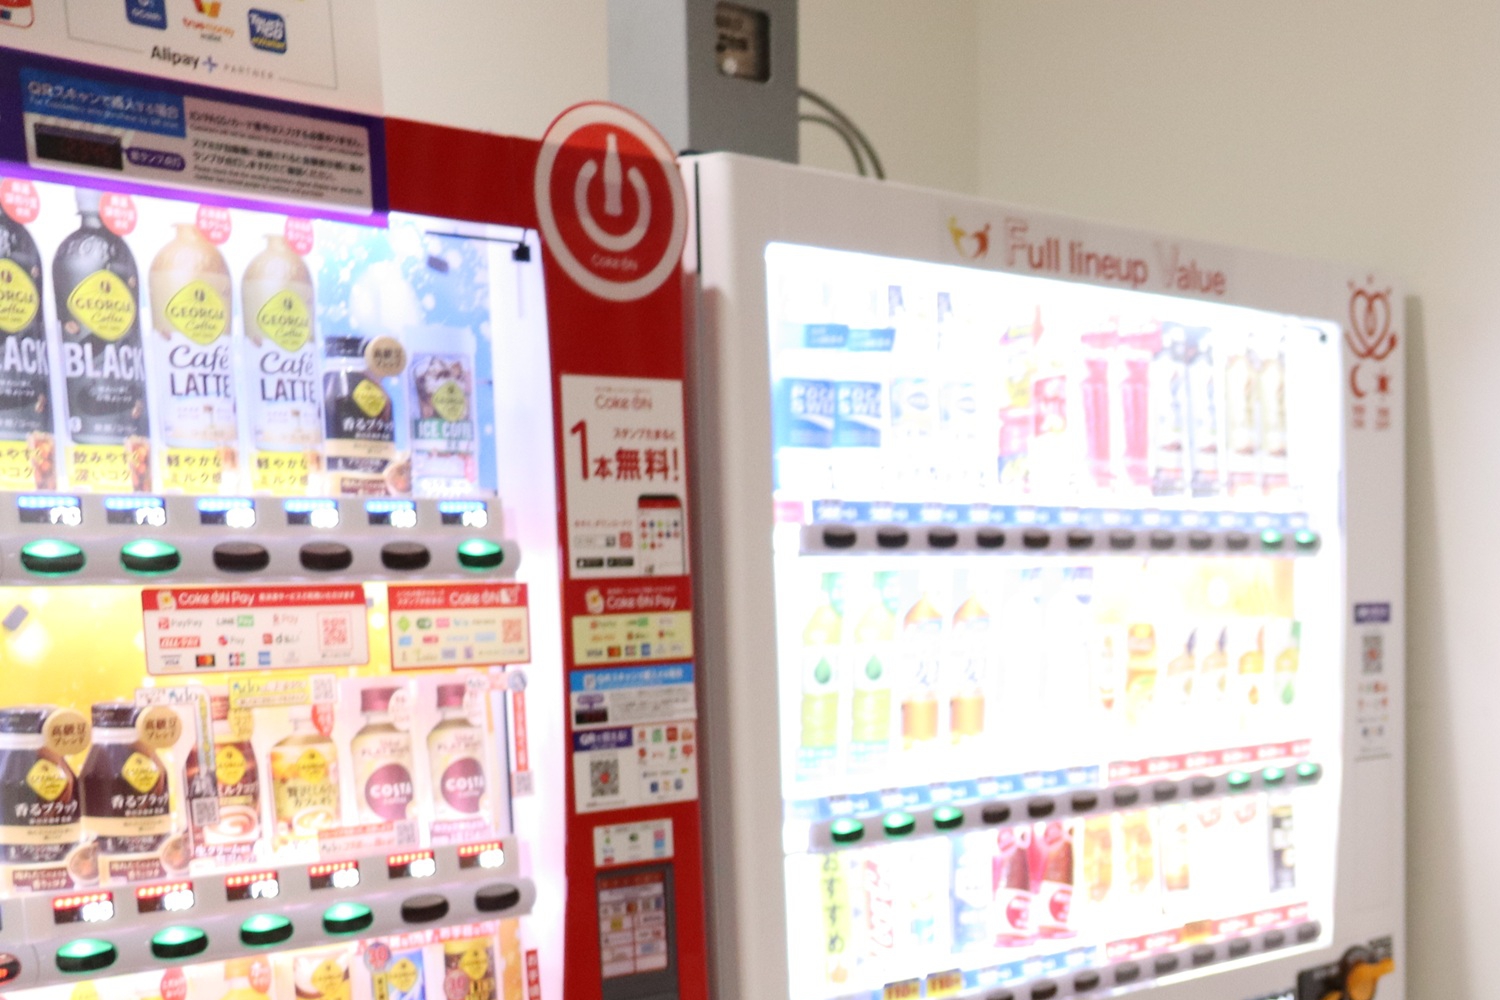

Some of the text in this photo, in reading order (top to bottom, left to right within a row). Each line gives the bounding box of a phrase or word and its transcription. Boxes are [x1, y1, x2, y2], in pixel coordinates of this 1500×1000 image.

[152, 46, 275, 80] Alipay PARTNER
[1005, 216, 1227, 295] Full lineup Value
[75, 297, 132, 314] GEORGIA
[170, 305, 225, 321] GEORGIA
[260, 312, 310, 328] GEORGIA
[0, 335, 50, 377] ACK
[65, 341, 146, 380] BLACK
[169, 345, 229, 371] Café
[260, 351, 314, 377] Café
[170, 372, 232, 399] LATTE
[260, 377, 316, 402] LATTE
[178, 591, 210, 606] Coke
[211, 589, 231, 604] ON
[232, 590, 255, 607] Pay
[449, 591, 481, 607] Coke
[606, 595, 636, 610] Coke
[657, 593, 678, 610] Pay
[171, 617, 203, 630] PayPay
[369, 780, 412, 798] COSTA
[445, 774, 484, 791] COSTA
[822, 852, 845, 954] おすすめ
